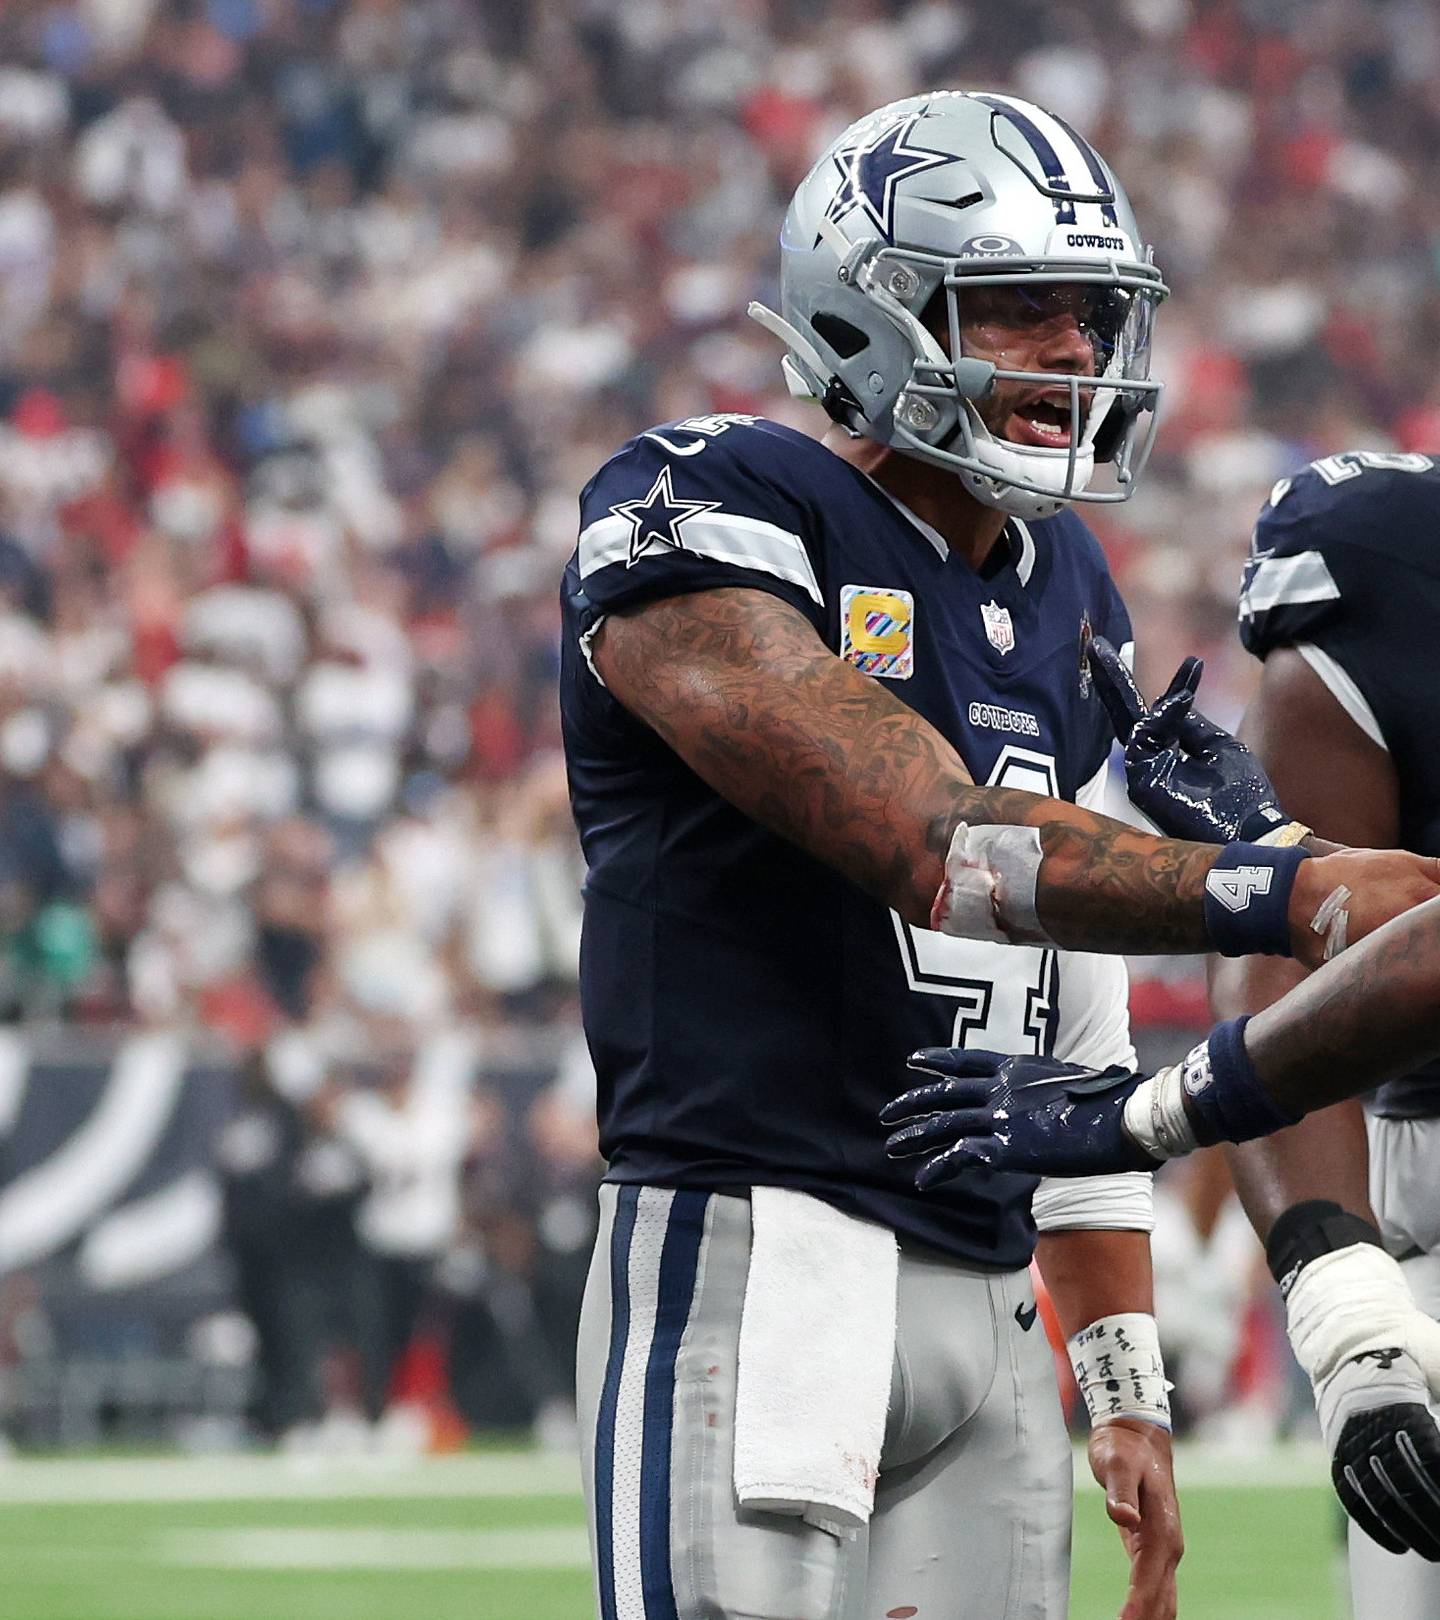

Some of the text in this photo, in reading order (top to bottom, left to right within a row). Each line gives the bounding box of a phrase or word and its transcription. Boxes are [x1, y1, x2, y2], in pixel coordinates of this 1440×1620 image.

[1067, 234, 1124, 250] COWBOYS
[849, 594, 910, 656] C
[969, 702, 1039, 736] COWBOYS
[1206, 866, 1273, 913] 4
